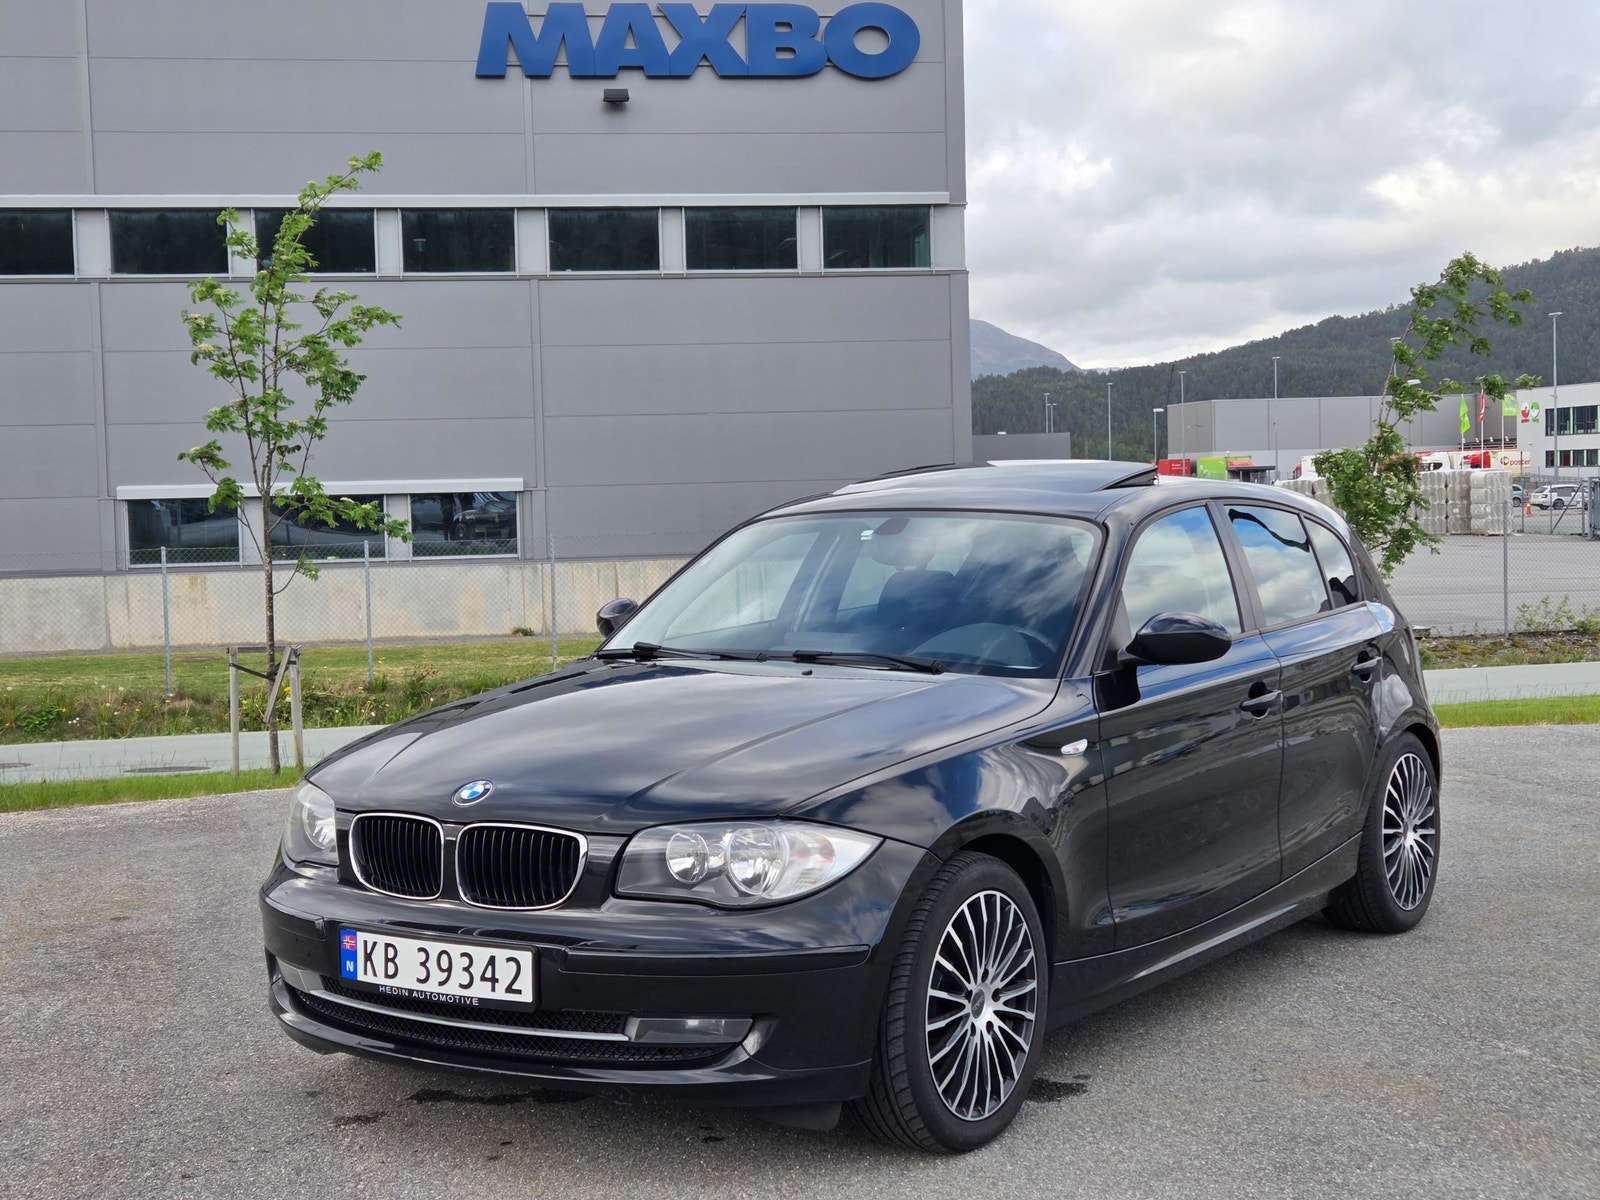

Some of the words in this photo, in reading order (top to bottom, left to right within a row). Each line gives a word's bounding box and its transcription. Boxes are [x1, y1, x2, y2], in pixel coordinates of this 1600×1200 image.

[476, 2, 920, 79] MAXBO
[345, 960, 354, 972] N
[363, 940, 399, 980] KB
[416, 946, 523, 995] 39342
[379, 985, 409, 997] HEDIN
[412, 991, 479, 1006] AUTOMOTIVE
